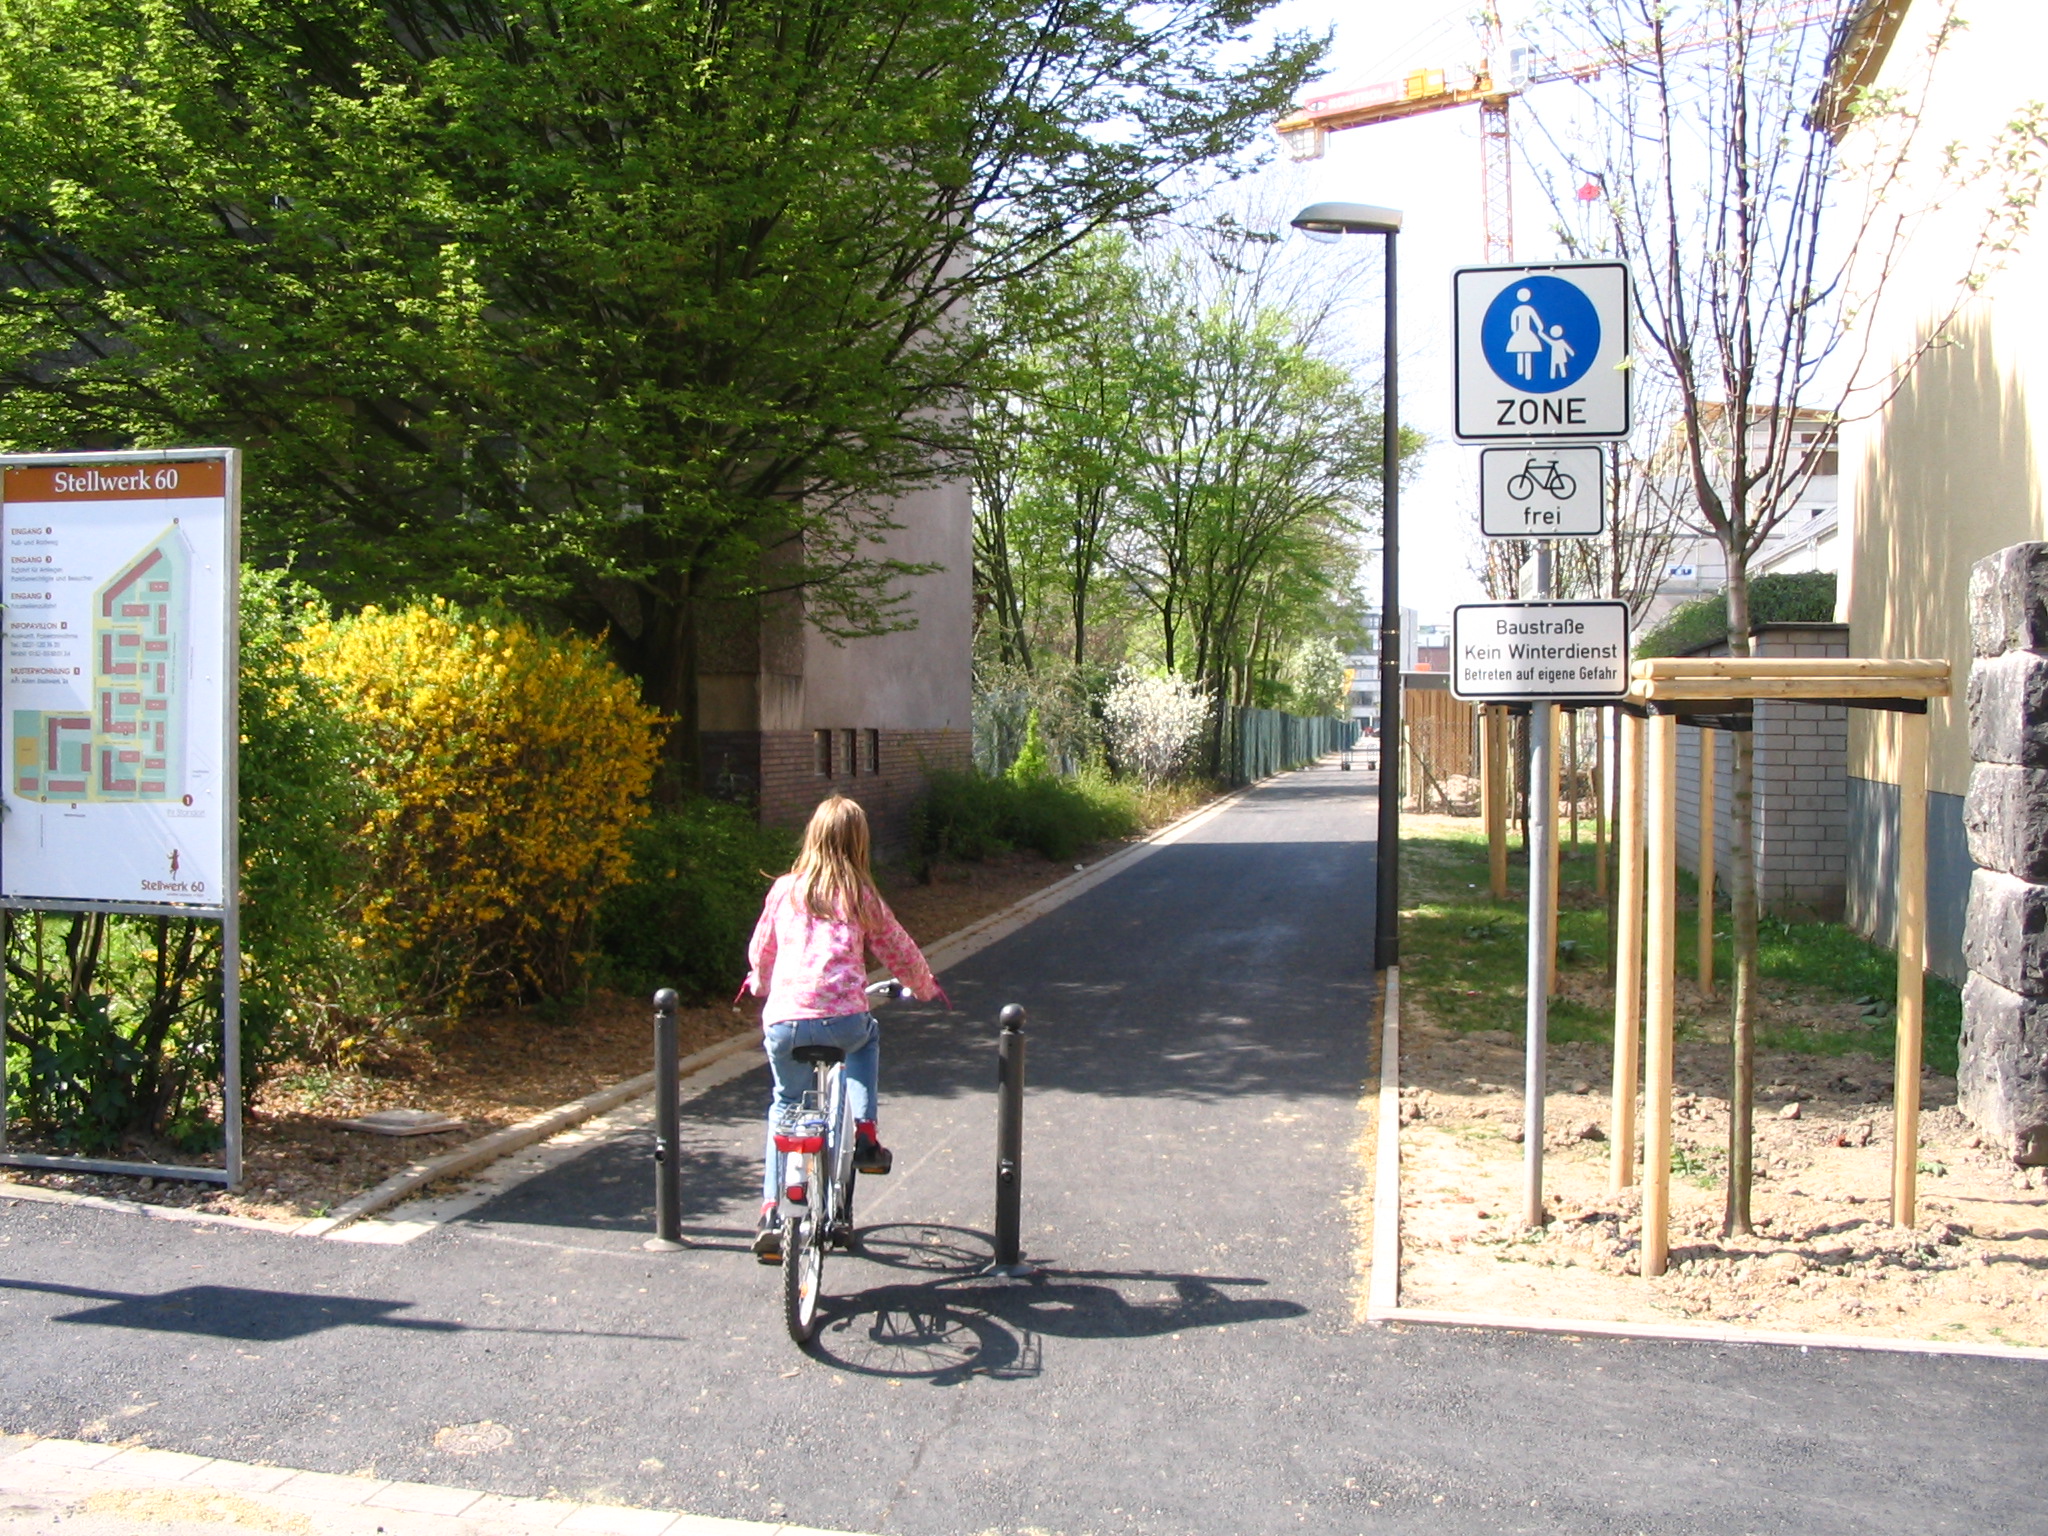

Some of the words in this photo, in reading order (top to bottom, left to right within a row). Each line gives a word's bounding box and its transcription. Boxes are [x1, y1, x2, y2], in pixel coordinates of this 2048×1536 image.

[1497, 397, 1586, 425] ZONE
[54, 470, 151, 493] Stellwerk
[154, 469, 178, 490] 60
[1524, 506, 1561, 525] frei
[1497, 619, 1585, 635] Baustraße
[1465, 645, 1501, 660] Kein
[1508, 643, 1618, 660] Winterdienst
[1465, 667, 1512, 681] Betreten
[1516, 667, 1534, 681] auf
[1538, 667, 1576, 683] eigene
[1579, 666, 1618, 680] Gefahr
[141, 880, 188, 891] Stellwerk
[191, 881, 205, 892] 60
